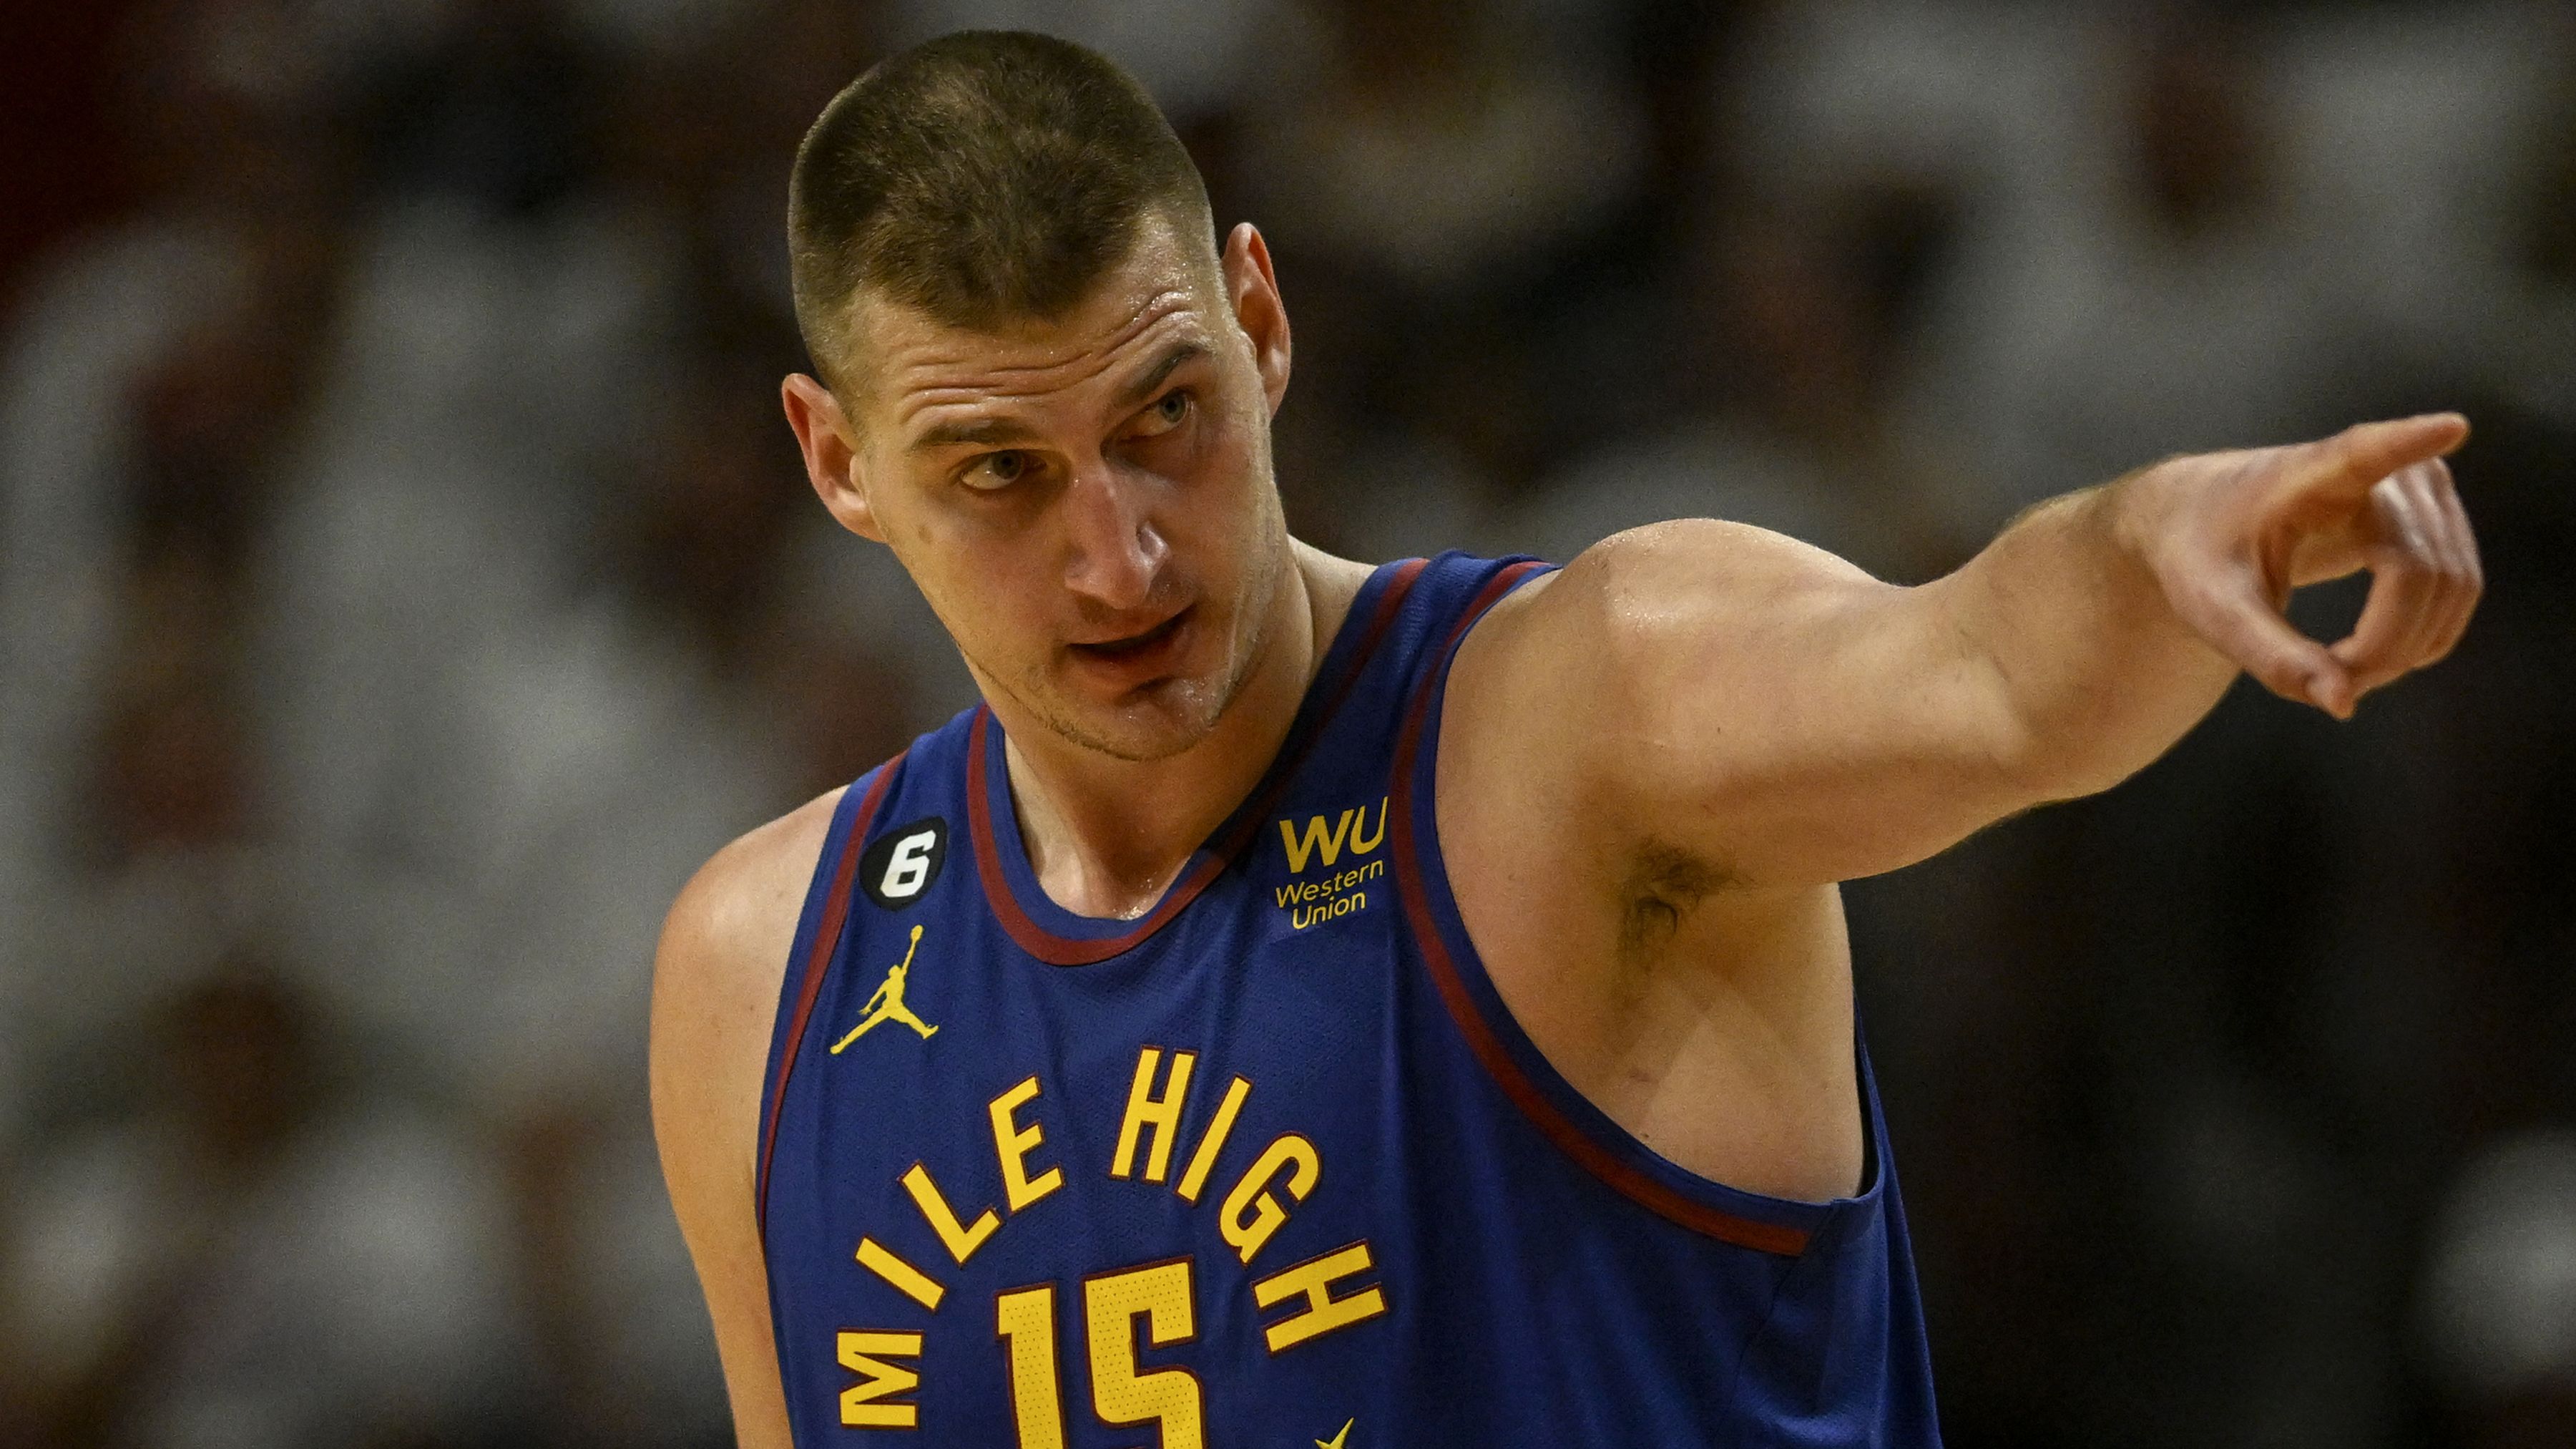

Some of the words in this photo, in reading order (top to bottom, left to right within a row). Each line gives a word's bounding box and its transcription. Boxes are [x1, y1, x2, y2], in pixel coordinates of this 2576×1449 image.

[879, 829, 937, 899] 6
[1278, 796, 1389, 874] WU
[1275, 859, 1384, 908] Western
[1292, 892, 1366, 930] Union
[836, 1073, 1064, 1430] MILE
[1109, 1045, 1389, 1355] HIGH
[996, 1255, 1207, 1449] 15
